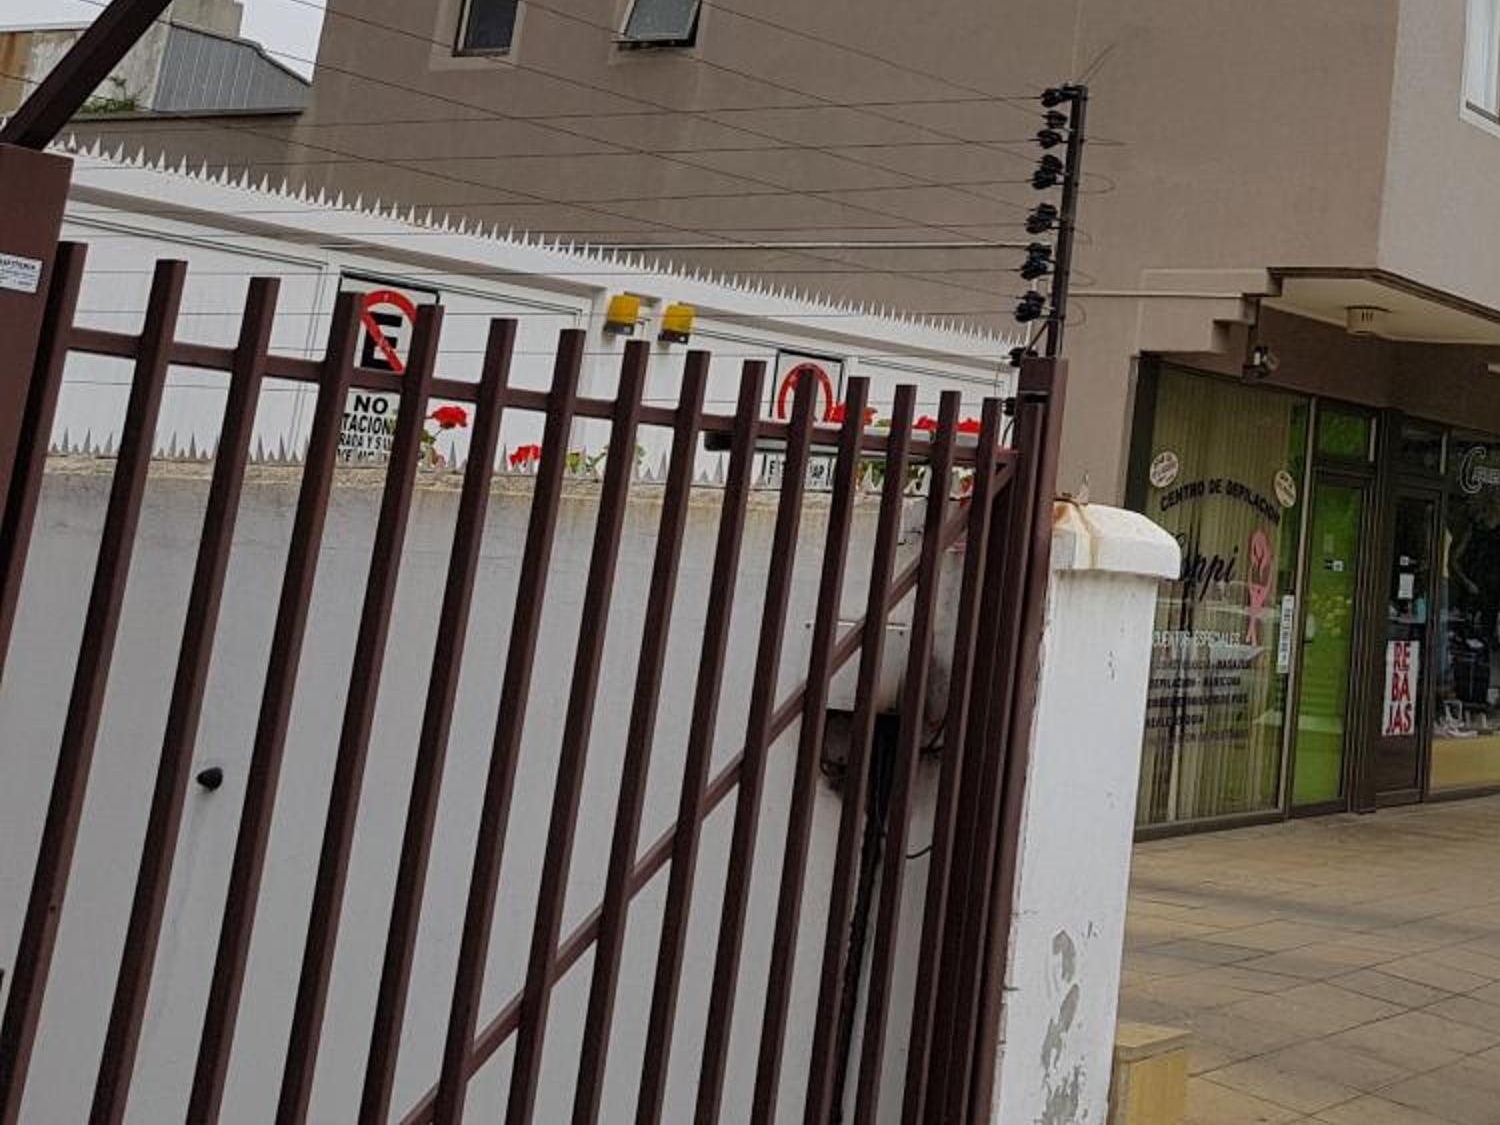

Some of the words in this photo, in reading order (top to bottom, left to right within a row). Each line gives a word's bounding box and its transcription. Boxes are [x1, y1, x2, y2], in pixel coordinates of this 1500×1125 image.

[353, 394, 389, 415] NO
[1160, 480, 1205, 512] CENTRO
[1208, 478, 1223, 495] DE
[1393, 642, 1411, 671] RE
[1391, 672, 1411, 701] BA
[1385, 702, 1413, 733] JAS
